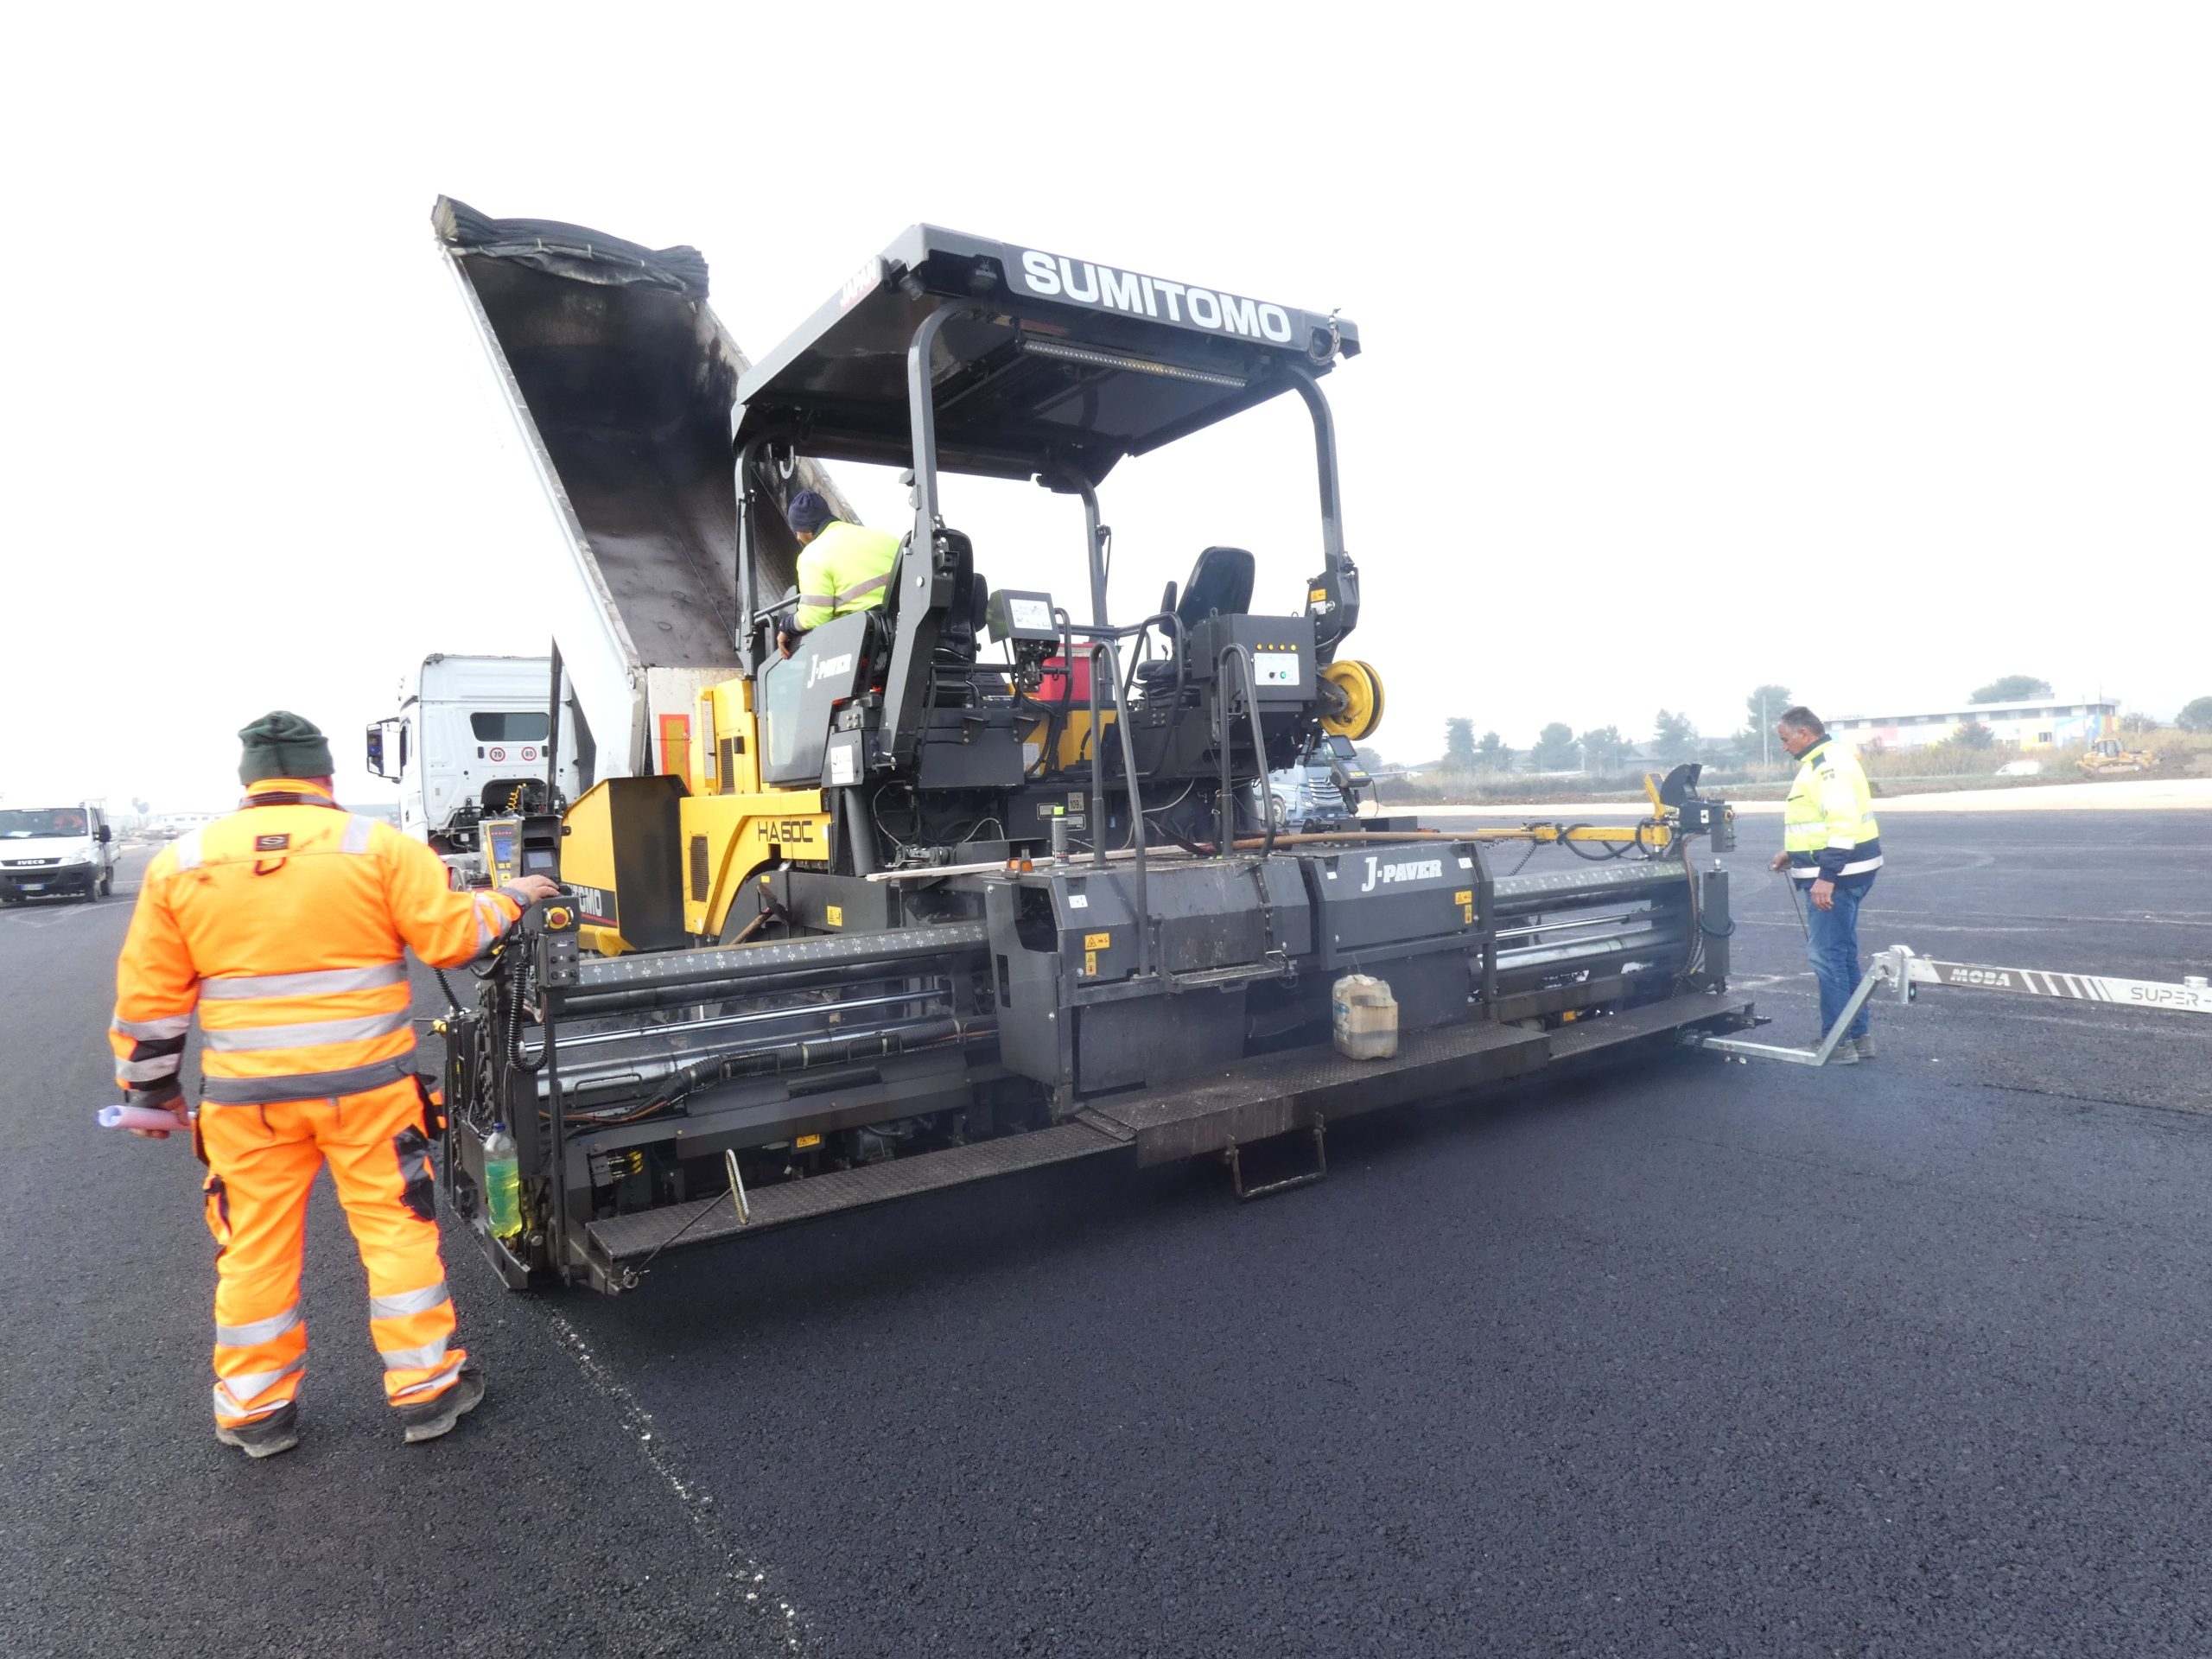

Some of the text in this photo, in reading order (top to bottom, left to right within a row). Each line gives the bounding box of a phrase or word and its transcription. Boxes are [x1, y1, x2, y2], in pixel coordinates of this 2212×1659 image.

[1022, 251, 1292, 343] SUMITOMO
[758, 821, 813, 842] HA60C
[1362, 856, 1442, 892] J-PAVER
[1949, 969, 2011, 986] MOBA
